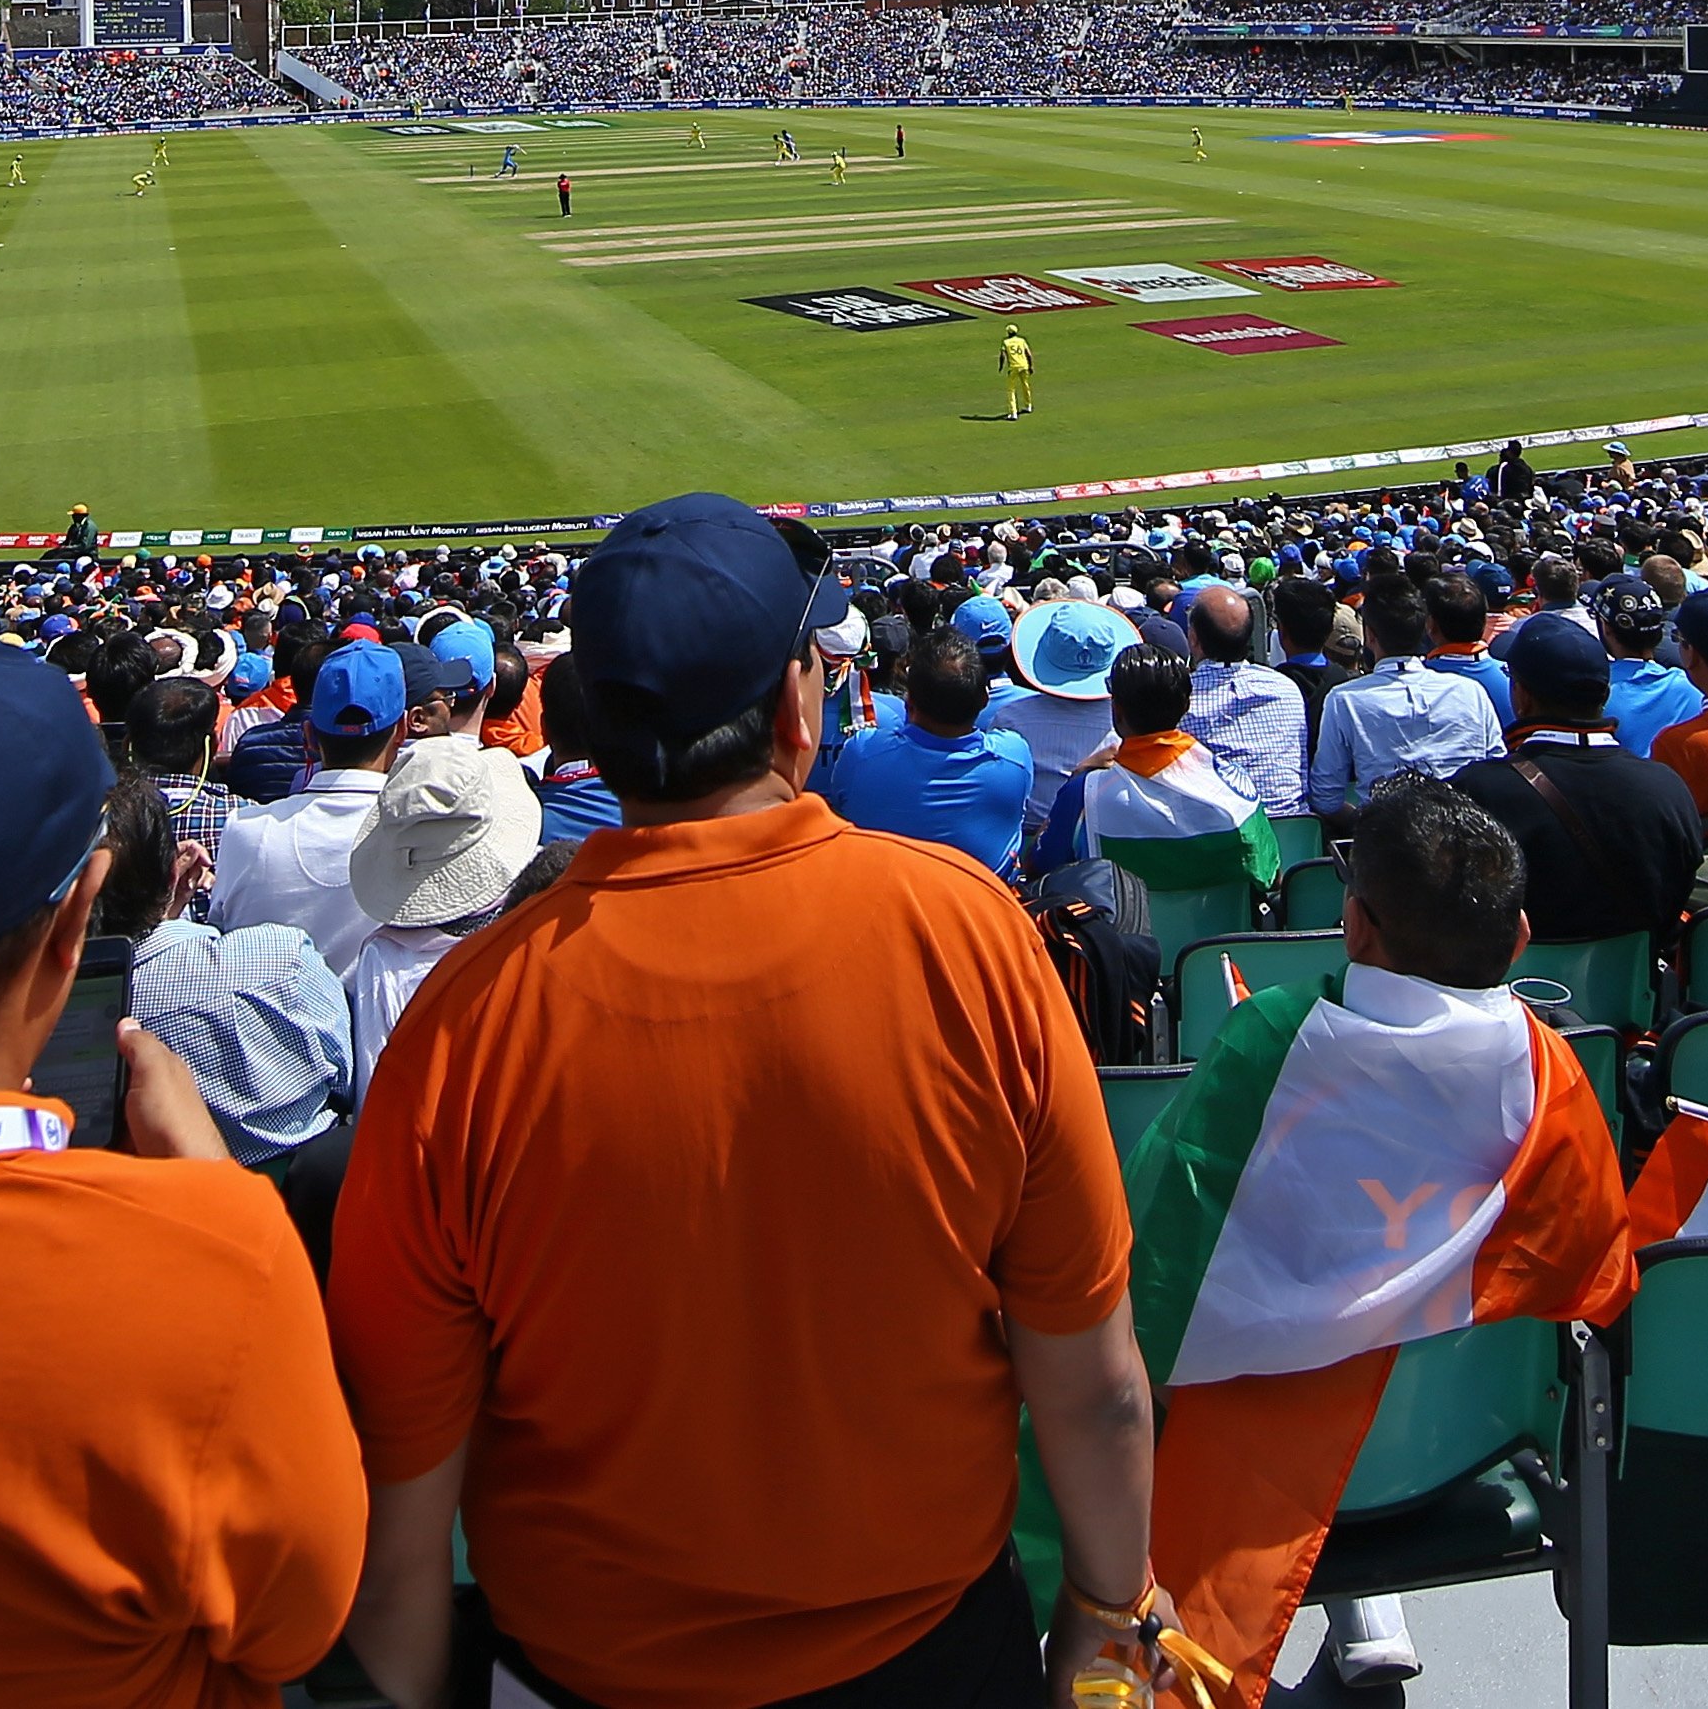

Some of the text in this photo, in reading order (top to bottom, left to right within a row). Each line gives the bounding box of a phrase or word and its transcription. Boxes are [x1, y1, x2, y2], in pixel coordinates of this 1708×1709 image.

[1010, 345, 1022, 355] 56
[837, 500, 884, 511] Booking.com
[432, 526, 468, 535] MOBILITY
[476, 522, 588, 534] NISSAN INTELLIGENT MOBILITY
[146, 534, 166, 542] oppo
[327, 530, 347, 538] oppo
